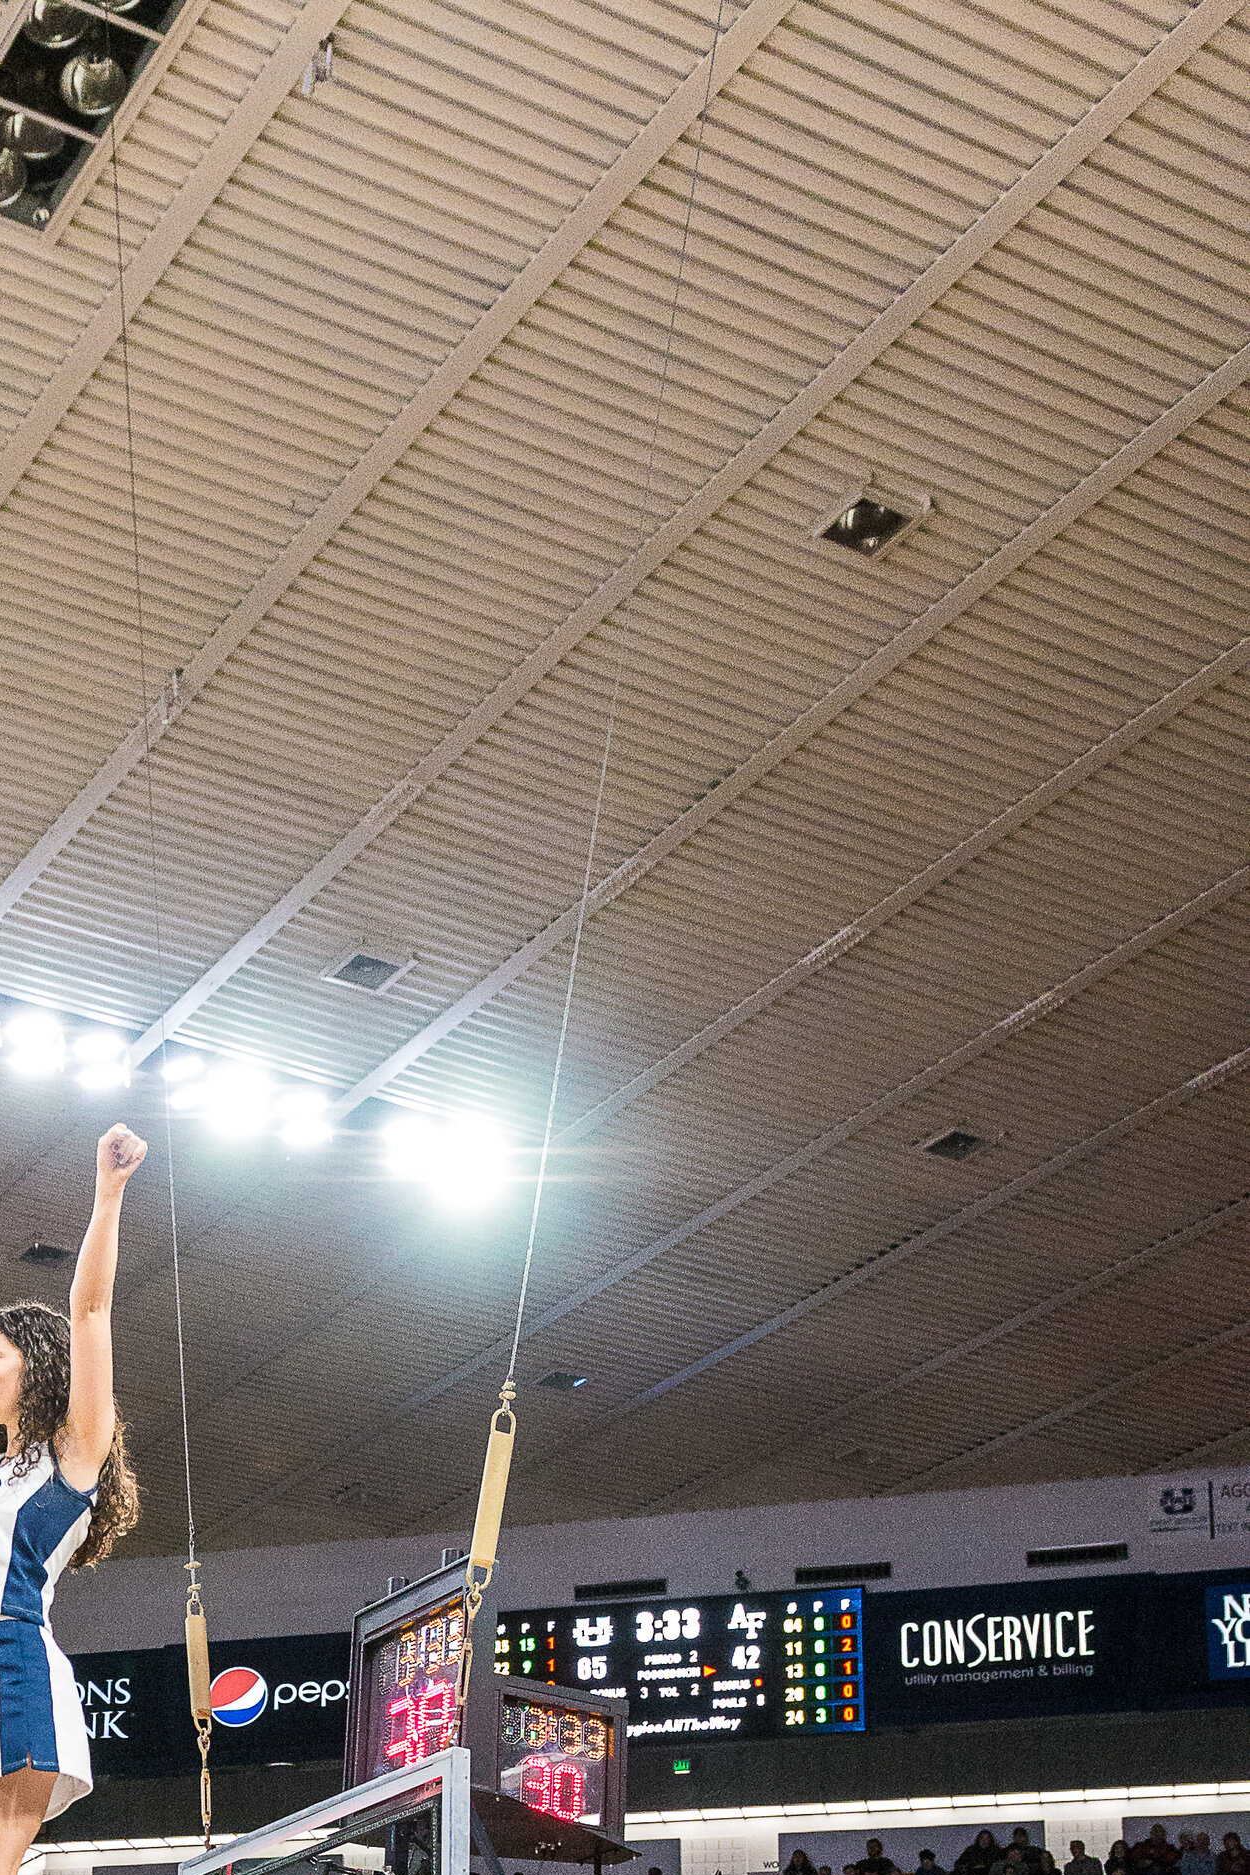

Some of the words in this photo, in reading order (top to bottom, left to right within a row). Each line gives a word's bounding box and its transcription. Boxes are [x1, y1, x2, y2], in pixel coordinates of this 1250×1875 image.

[635, 1607, 701, 1643] 3:33
[841, 1614, 852, 1629] 0
[519, 1638, 536, 1652] 15
[547, 1636, 555, 1650] 1
[785, 1641, 803, 1656] 11
[841, 1638, 852, 1652] 2
[901, 1609, 1096, 1668] CONSERVICE
[689, 1650, 699, 1663] 2
[731, 1645, 761, 1670] 42
[522, 1660, 532, 1674] 9
[547, 1659, 556, 1672] 1
[785, 1663, 804, 1679] 13
[843, 1661, 852, 1675] 1
[905, 1673, 938, 1686] utility
[941, 1666, 1034, 1684] management
[1038, 1665, 1049, 1677] &
[1052, 1663, 1094, 1678] billing
[273, 1680, 350, 1710] pep
[639, 1687, 649, 1699] 3
[690, 1683, 700, 1696] 2
[842, 1684, 853, 1698] 0
[785, 1710, 805, 1725] 24
[816, 1708, 827, 1723] 3
[843, 1707, 854, 1721] 0
[524, 1757, 583, 1821] 30
